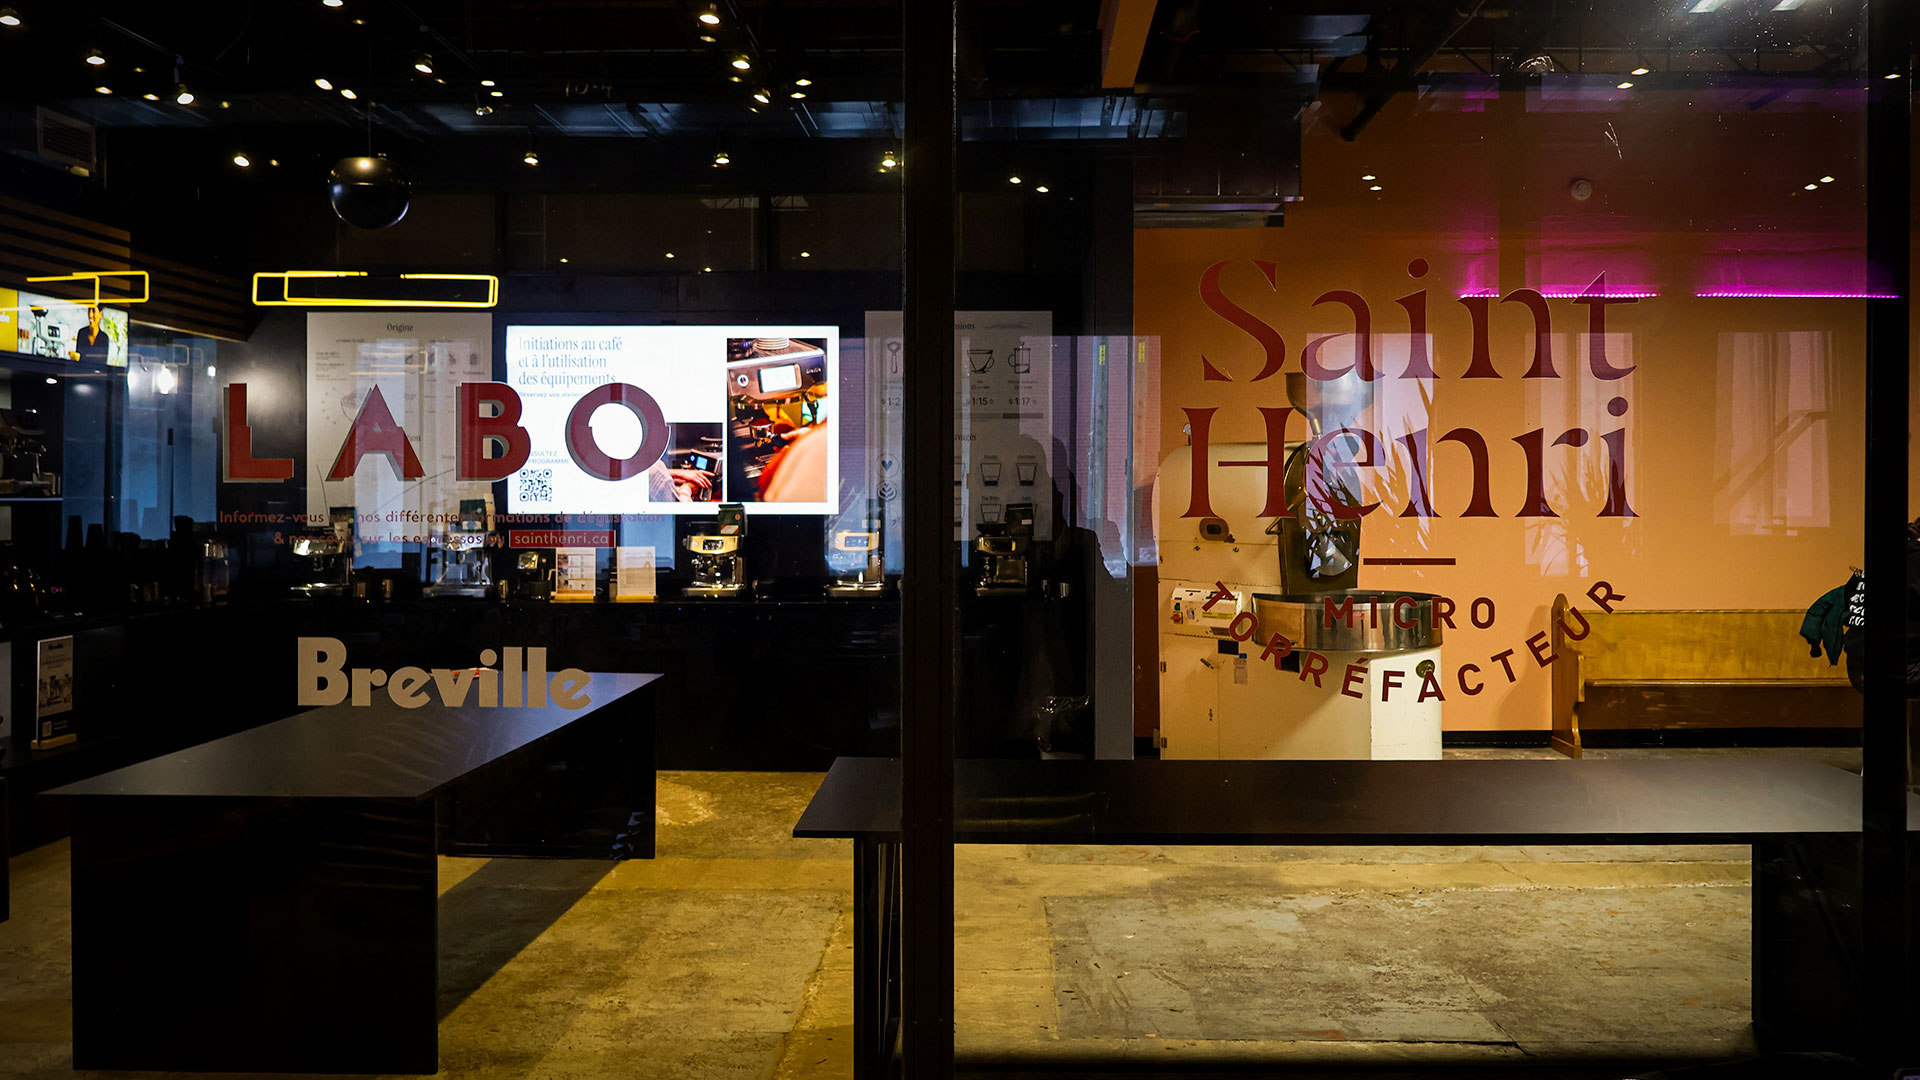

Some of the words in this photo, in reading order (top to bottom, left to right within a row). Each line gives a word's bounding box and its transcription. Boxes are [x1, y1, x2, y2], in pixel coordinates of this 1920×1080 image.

[386, 322, 414, 333] Origine
[1199, 257, 1640, 382] Saint
[519, 336, 578, 351] Initiations
[581, 339, 596, 351] au
[598, 336, 623, 351] café
[518, 356, 529, 368] et
[531, 354, 539, 368] à
[542, 354, 607, 368] l'utilisation
[518, 371, 538, 386] des
[540, 371, 616, 388] équipements
[222, 381, 671, 483] LABO
[1180, 396, 1641, 518] Henri
[219, 510, 325, 524] Informez-vous
[356, 512, 381, 524] nos
[554, 510, 573, 524] de
[577, 509, 666, 528] dégustation
[273, 531, 286, 545] &
[389, 531, 408, 545] les
[514, 531, 609, 545] sainthenri.ca
[1324, 596, 1496, 630] MICRO
[1202, 580, 1626, 702] TORRÉFACTEUR
[297, 636, 592, 710] Breville
